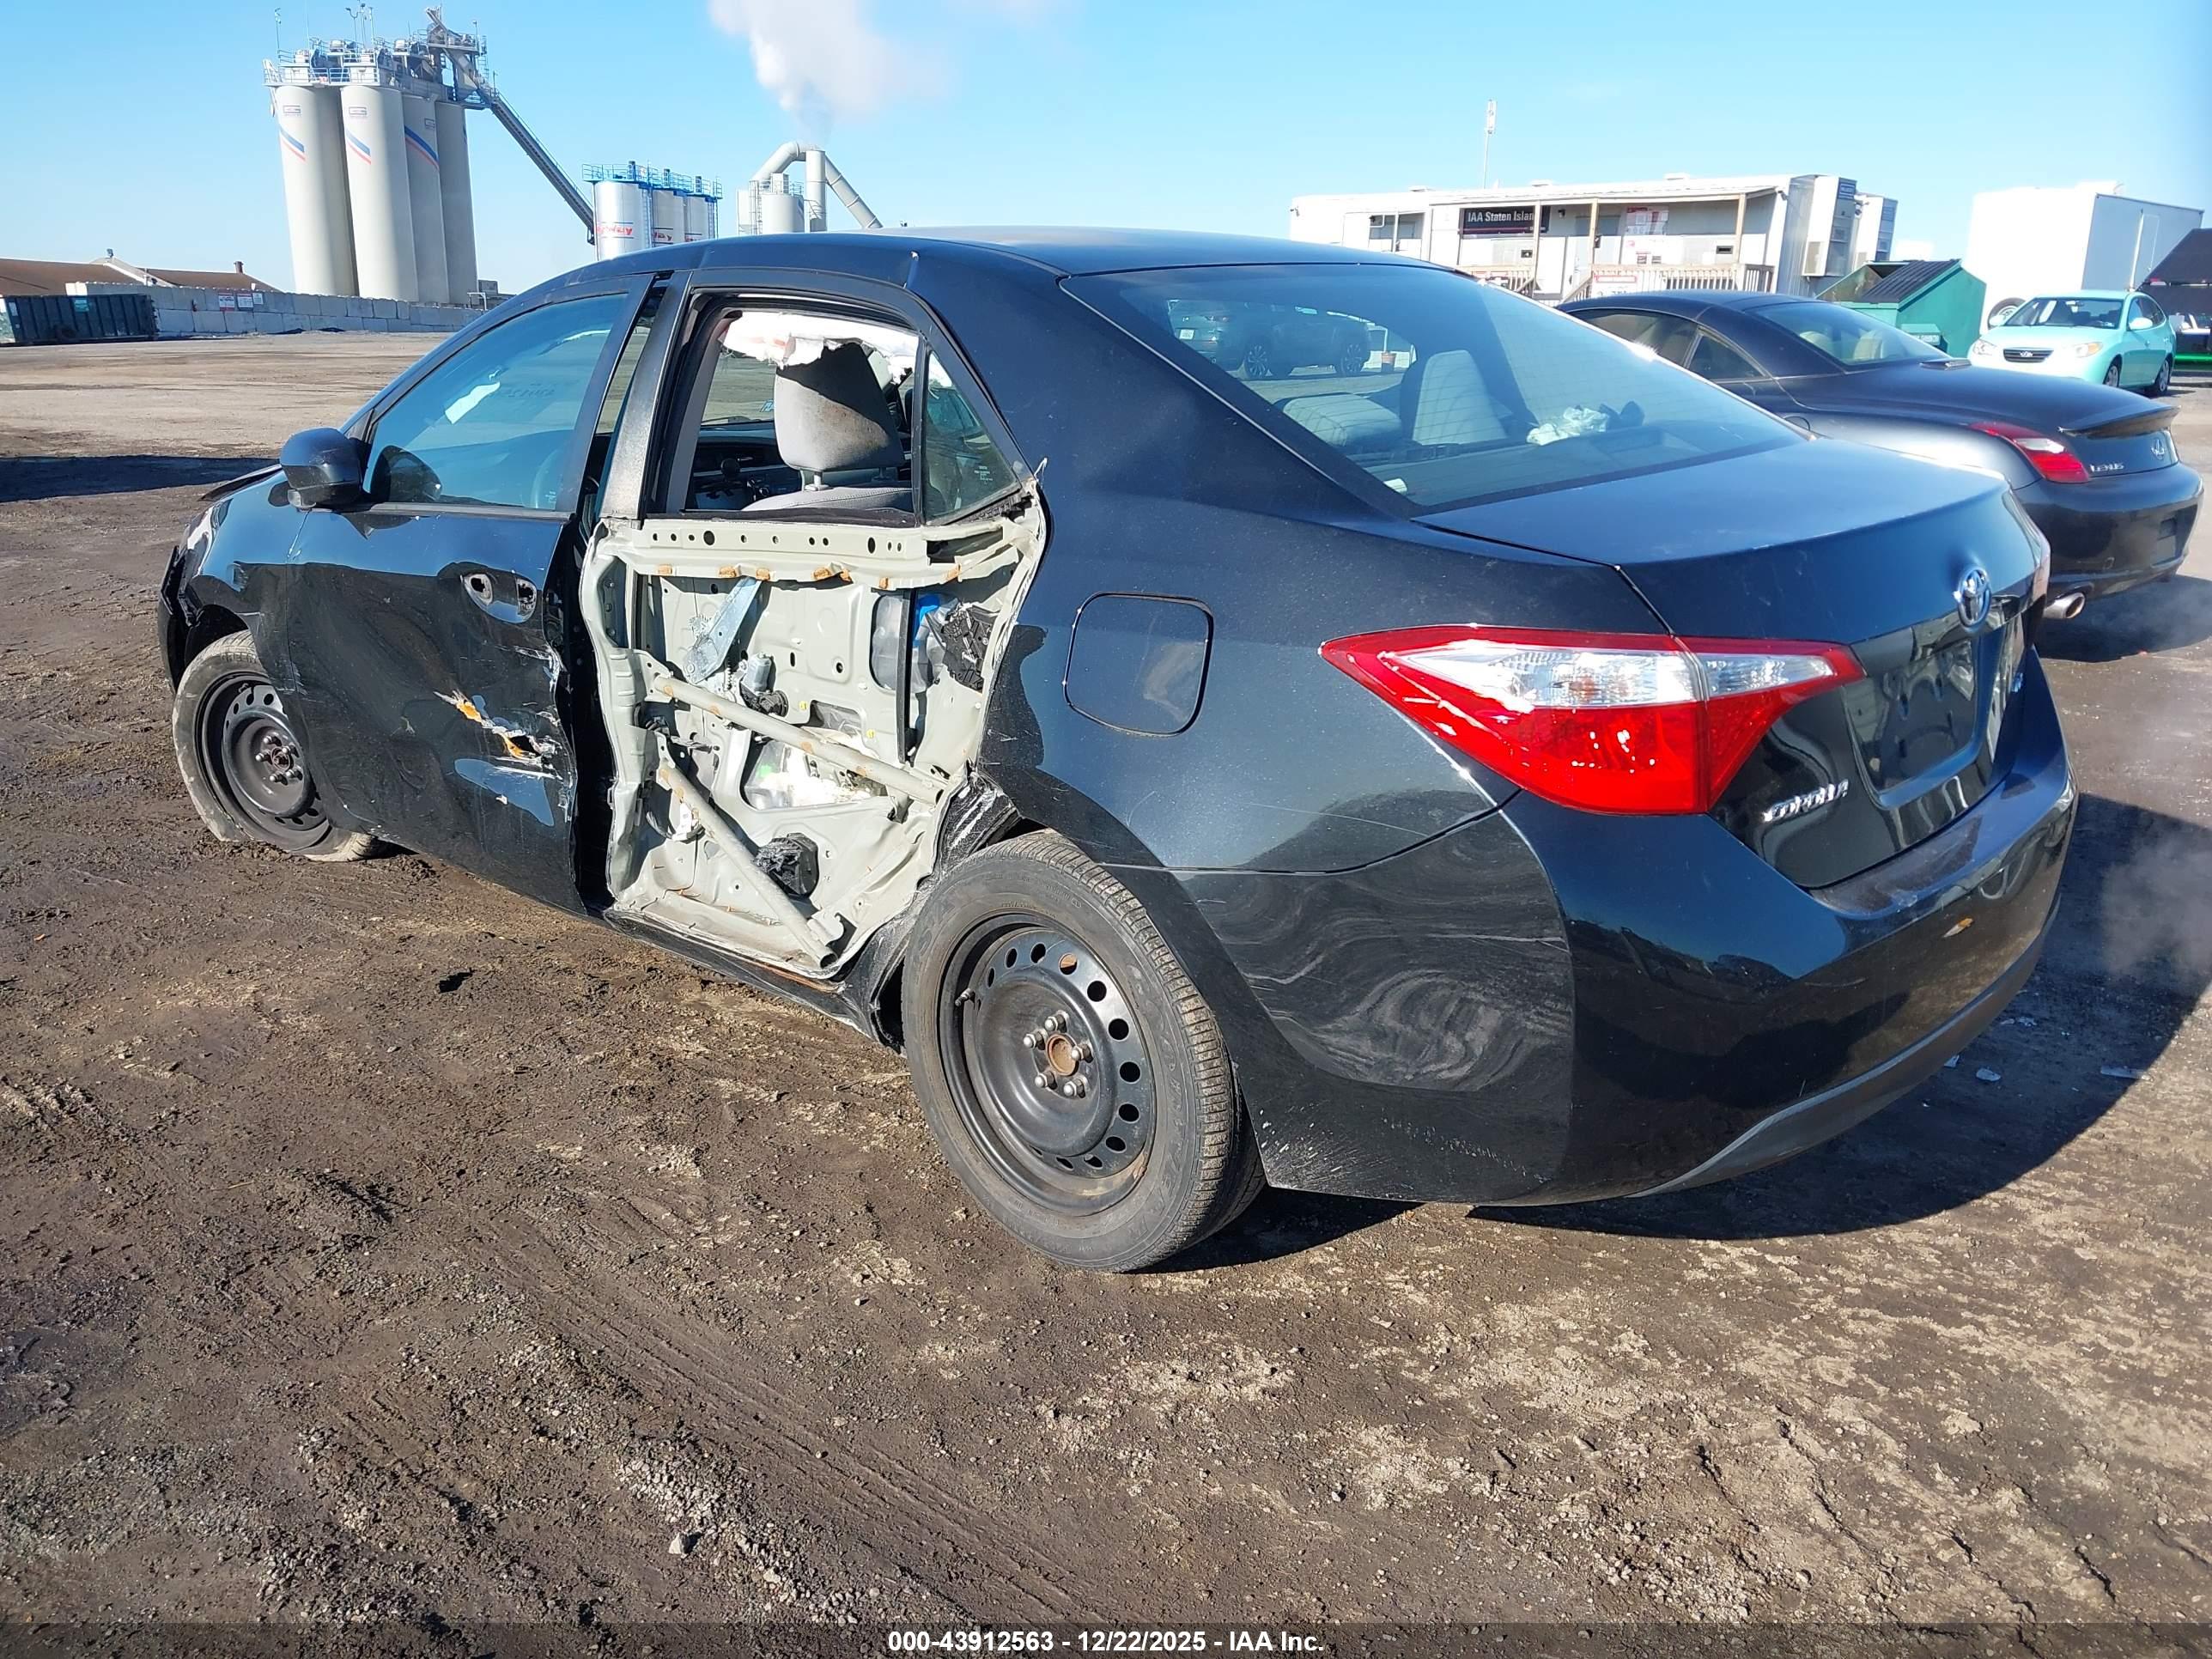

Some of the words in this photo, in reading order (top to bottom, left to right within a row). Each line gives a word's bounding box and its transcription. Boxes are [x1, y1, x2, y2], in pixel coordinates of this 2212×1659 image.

[1468, 212, 1483, 222] IAA
[1485, 211, 1511, 222] Staten
[1513, 210, 1534, 221] Islan
